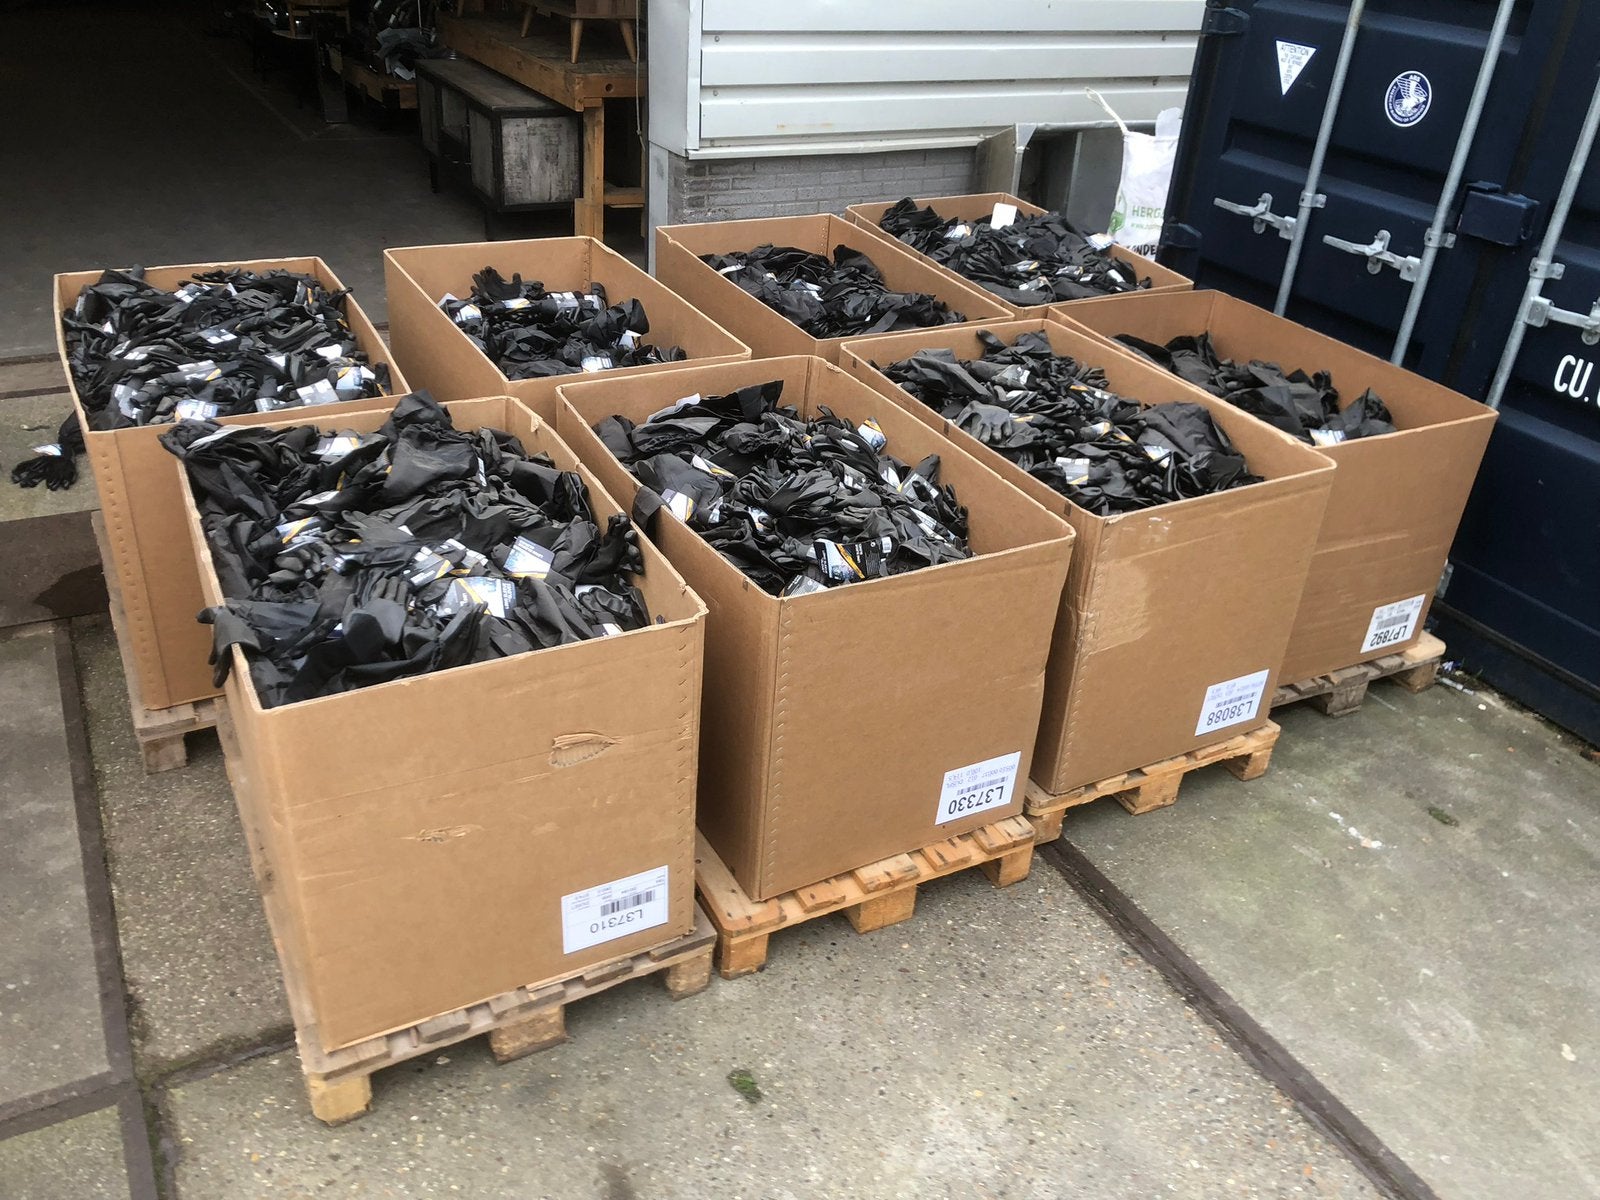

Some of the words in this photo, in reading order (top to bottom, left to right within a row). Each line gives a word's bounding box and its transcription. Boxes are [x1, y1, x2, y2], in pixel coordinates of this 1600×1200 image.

[1280, 43, 1309, 56] ATTENTION
[1553, 354, 1594, 402] CU.
[1370, 624, 1408, 647] LP7892
[1207, 700, 1253, 726] L38088
[948, 785, 1004, 815] L37330
[590, 908, 643, 934] L37310
